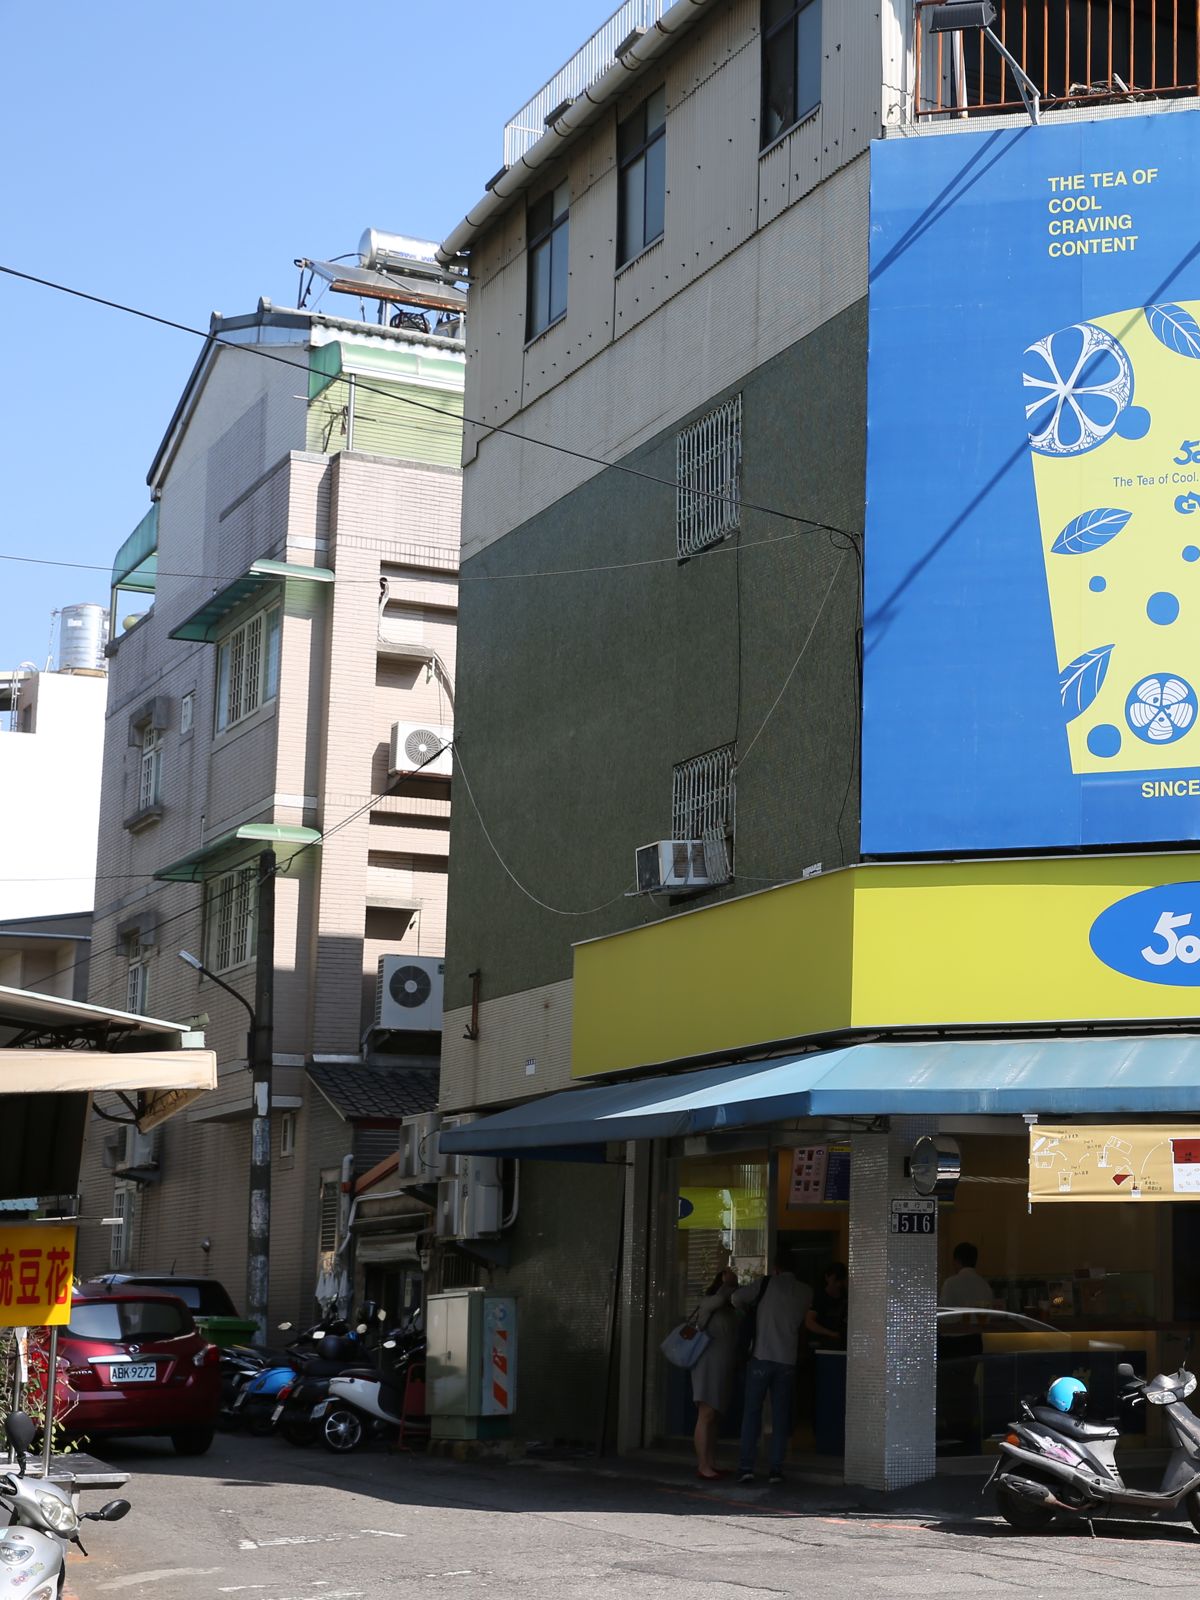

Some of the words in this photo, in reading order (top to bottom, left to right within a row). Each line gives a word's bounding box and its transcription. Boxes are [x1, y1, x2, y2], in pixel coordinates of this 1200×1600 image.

[1048, 175, 1085, 192] THE
[1090, 171, 1127, 188] TEA
[1132, 168, 1158, 184] OF
[1048, 196, 1102, 213] COOL
[1048, 214, 1132, 235] CRAVING
[1048, 236, 1138, 257] CONTENT
[1113, 477, 1133, 487] The
[1137, 475, 1154, 486] Tea
[1158, 473, 1169, 484] of
[1172, 472, 1199, 483] Cool.
[1141, 780, 1200, 798] SINCE
[901, 1215, 930, 1232] 516
[111, 1366, 156, 1380] ABK-9272
